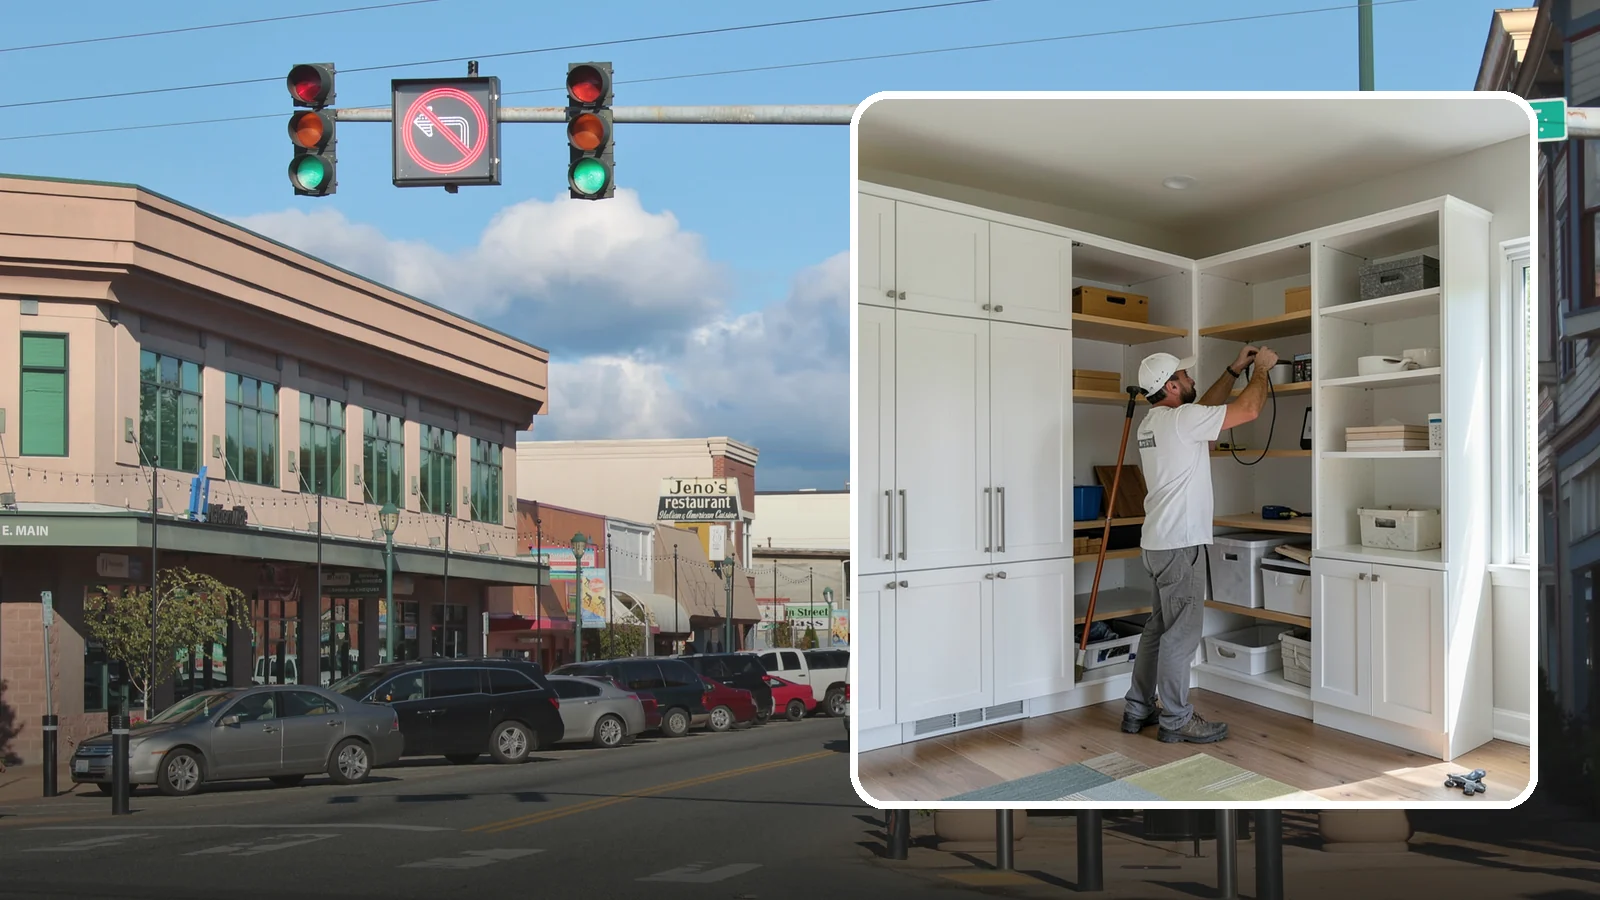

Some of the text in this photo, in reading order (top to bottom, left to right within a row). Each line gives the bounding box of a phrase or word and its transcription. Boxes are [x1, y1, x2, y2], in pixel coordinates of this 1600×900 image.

[669, 480, 728, 495] Jeno's
[665, 496, 731, 509] restaurant
[658, 509, 682, 520] Italian
[686, 509, 714, 519] American
[714, 509, 738, 519] Cuisine
[2, 525, 49, 536] E. MAIN
[786, 607, 795, 617] in
[797, 607, 828, 617] Street
[790, 619, 823, 627] lass
